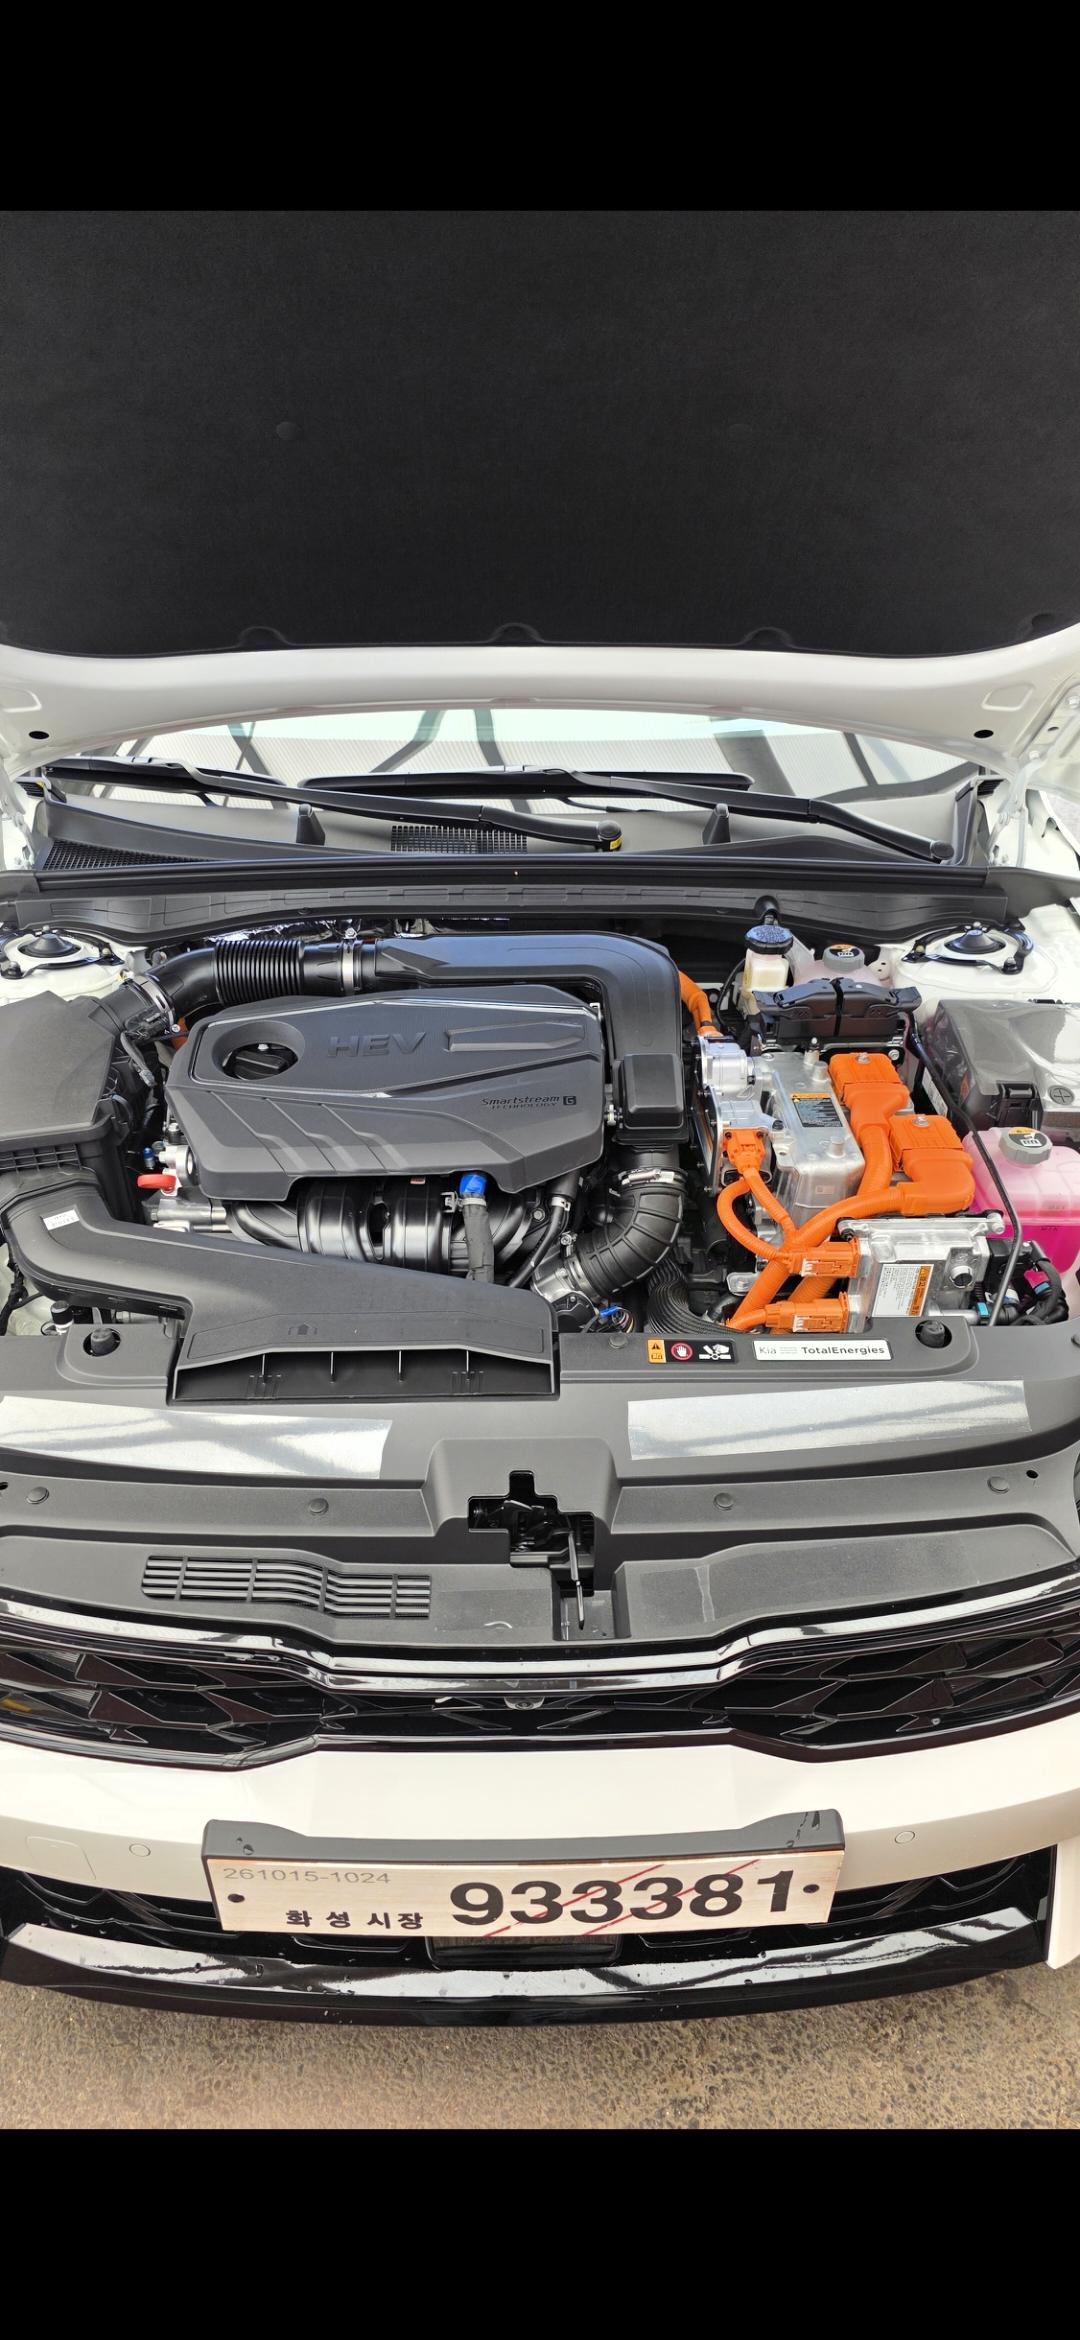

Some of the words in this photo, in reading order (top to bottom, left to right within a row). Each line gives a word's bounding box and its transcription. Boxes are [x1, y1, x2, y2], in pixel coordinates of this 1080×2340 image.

[328, 1032, 426, 1057] HEV
[481, 1096, 560, 1106] Smartstream
[758, 1346, 777, 1355] Kia
[801, 1345, 885, 1356] TotalEnergies
[223, 1868, 391, 1884] 261015-1024
[450, 1870, 794, 1926] 933381
